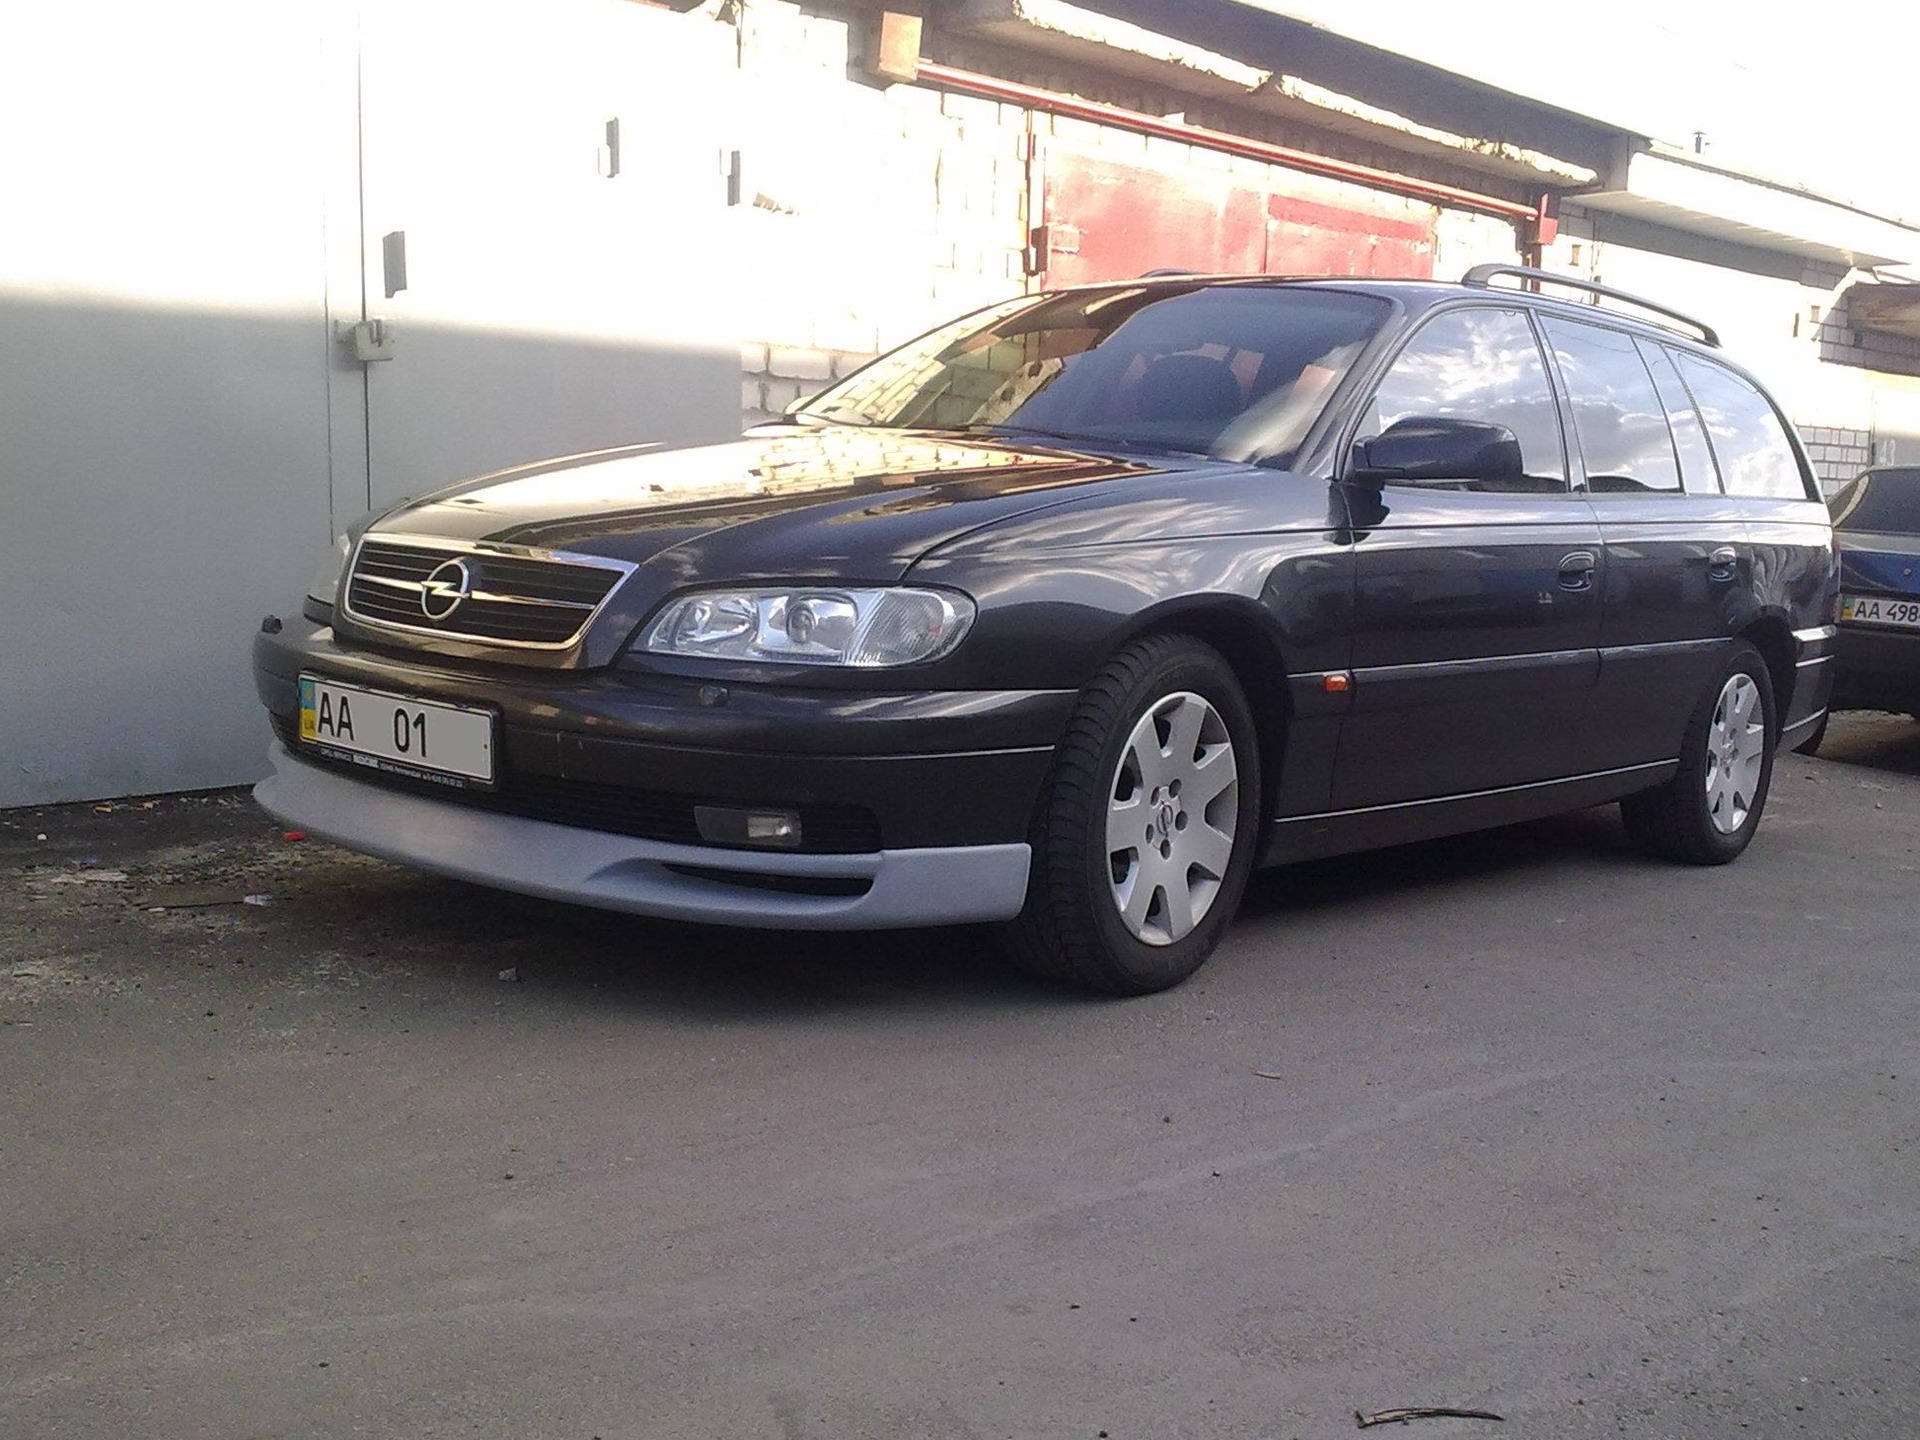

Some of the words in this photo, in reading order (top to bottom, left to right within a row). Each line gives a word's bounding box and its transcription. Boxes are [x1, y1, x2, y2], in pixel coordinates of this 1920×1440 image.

[1854, 600, 1880, 619] AA
[1886, 602, 1920, 622] 498
[318, 691, 354, 741] AA
[394, 707, 426, 758] 01
